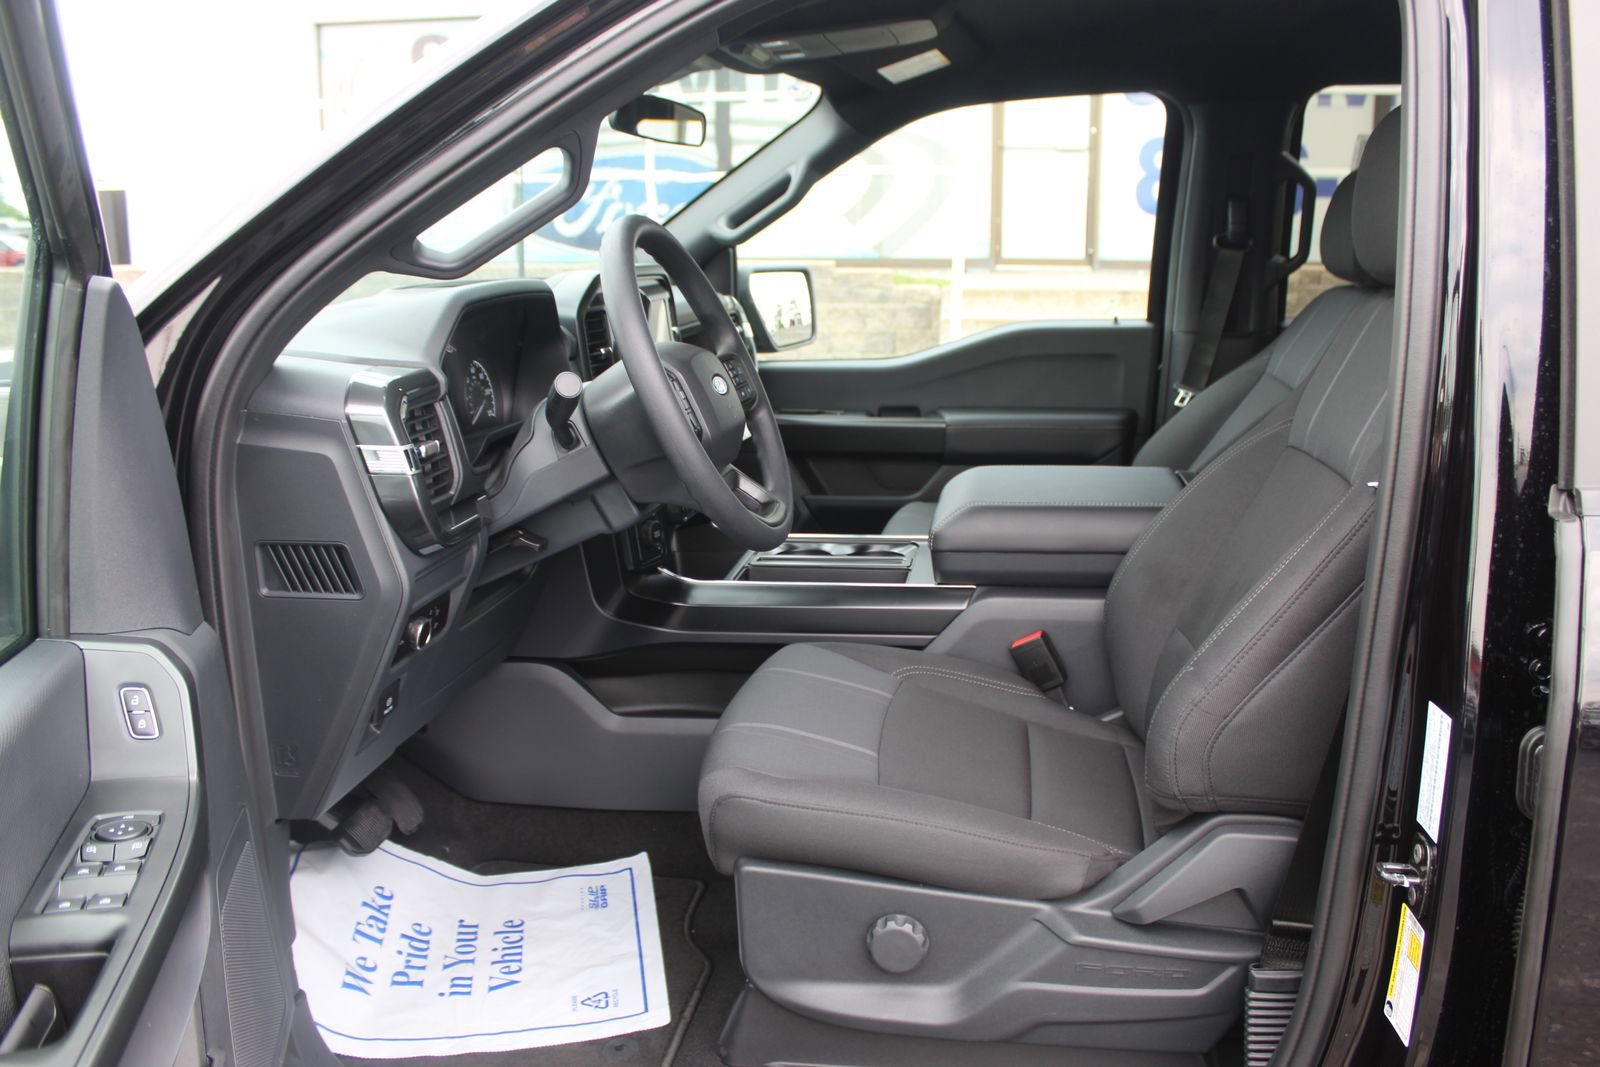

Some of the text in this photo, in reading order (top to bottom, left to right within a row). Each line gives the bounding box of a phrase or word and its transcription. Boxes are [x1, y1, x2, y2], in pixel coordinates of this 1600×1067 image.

[341, 885, 394, 996] We Take
[390, 922, 432, 988] Pride
[437, 919, 479, 998] in Your
[487, 919, 525, 993] Vehicle
